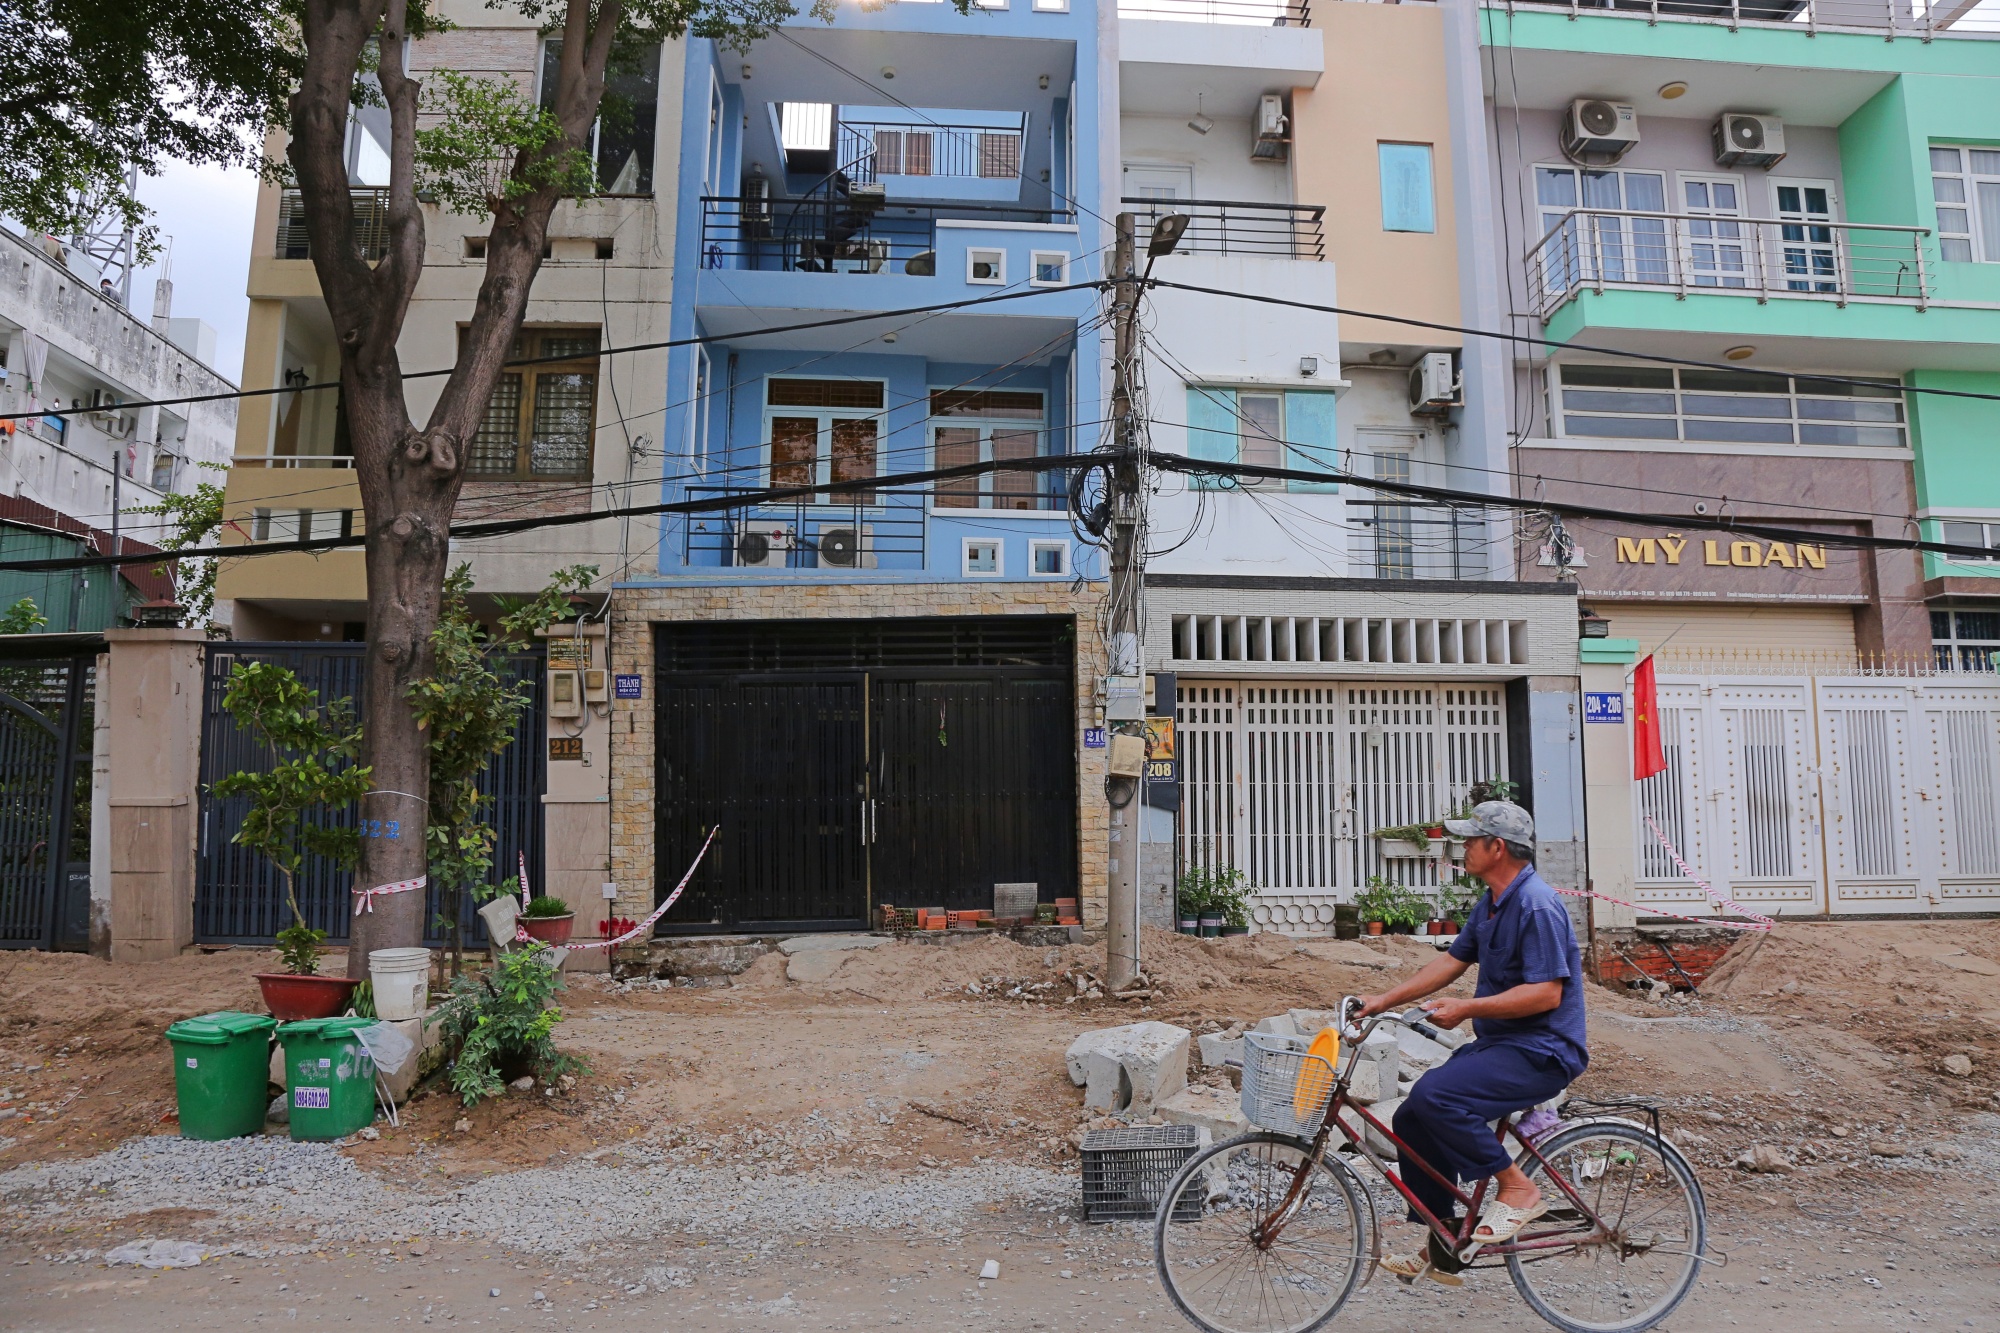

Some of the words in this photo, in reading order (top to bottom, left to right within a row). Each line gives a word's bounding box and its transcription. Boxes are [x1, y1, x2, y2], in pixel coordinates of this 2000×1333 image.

[1616, 532, 1688, 564] MỸ
[1704, 539, 1826, 569] LOAN
[1587, 696, 1601, 713] 204
[1607, 696, 1621, 713] 206
[551, 740, 581, 754] 212
[1148, 763, 1171, 777] 208
